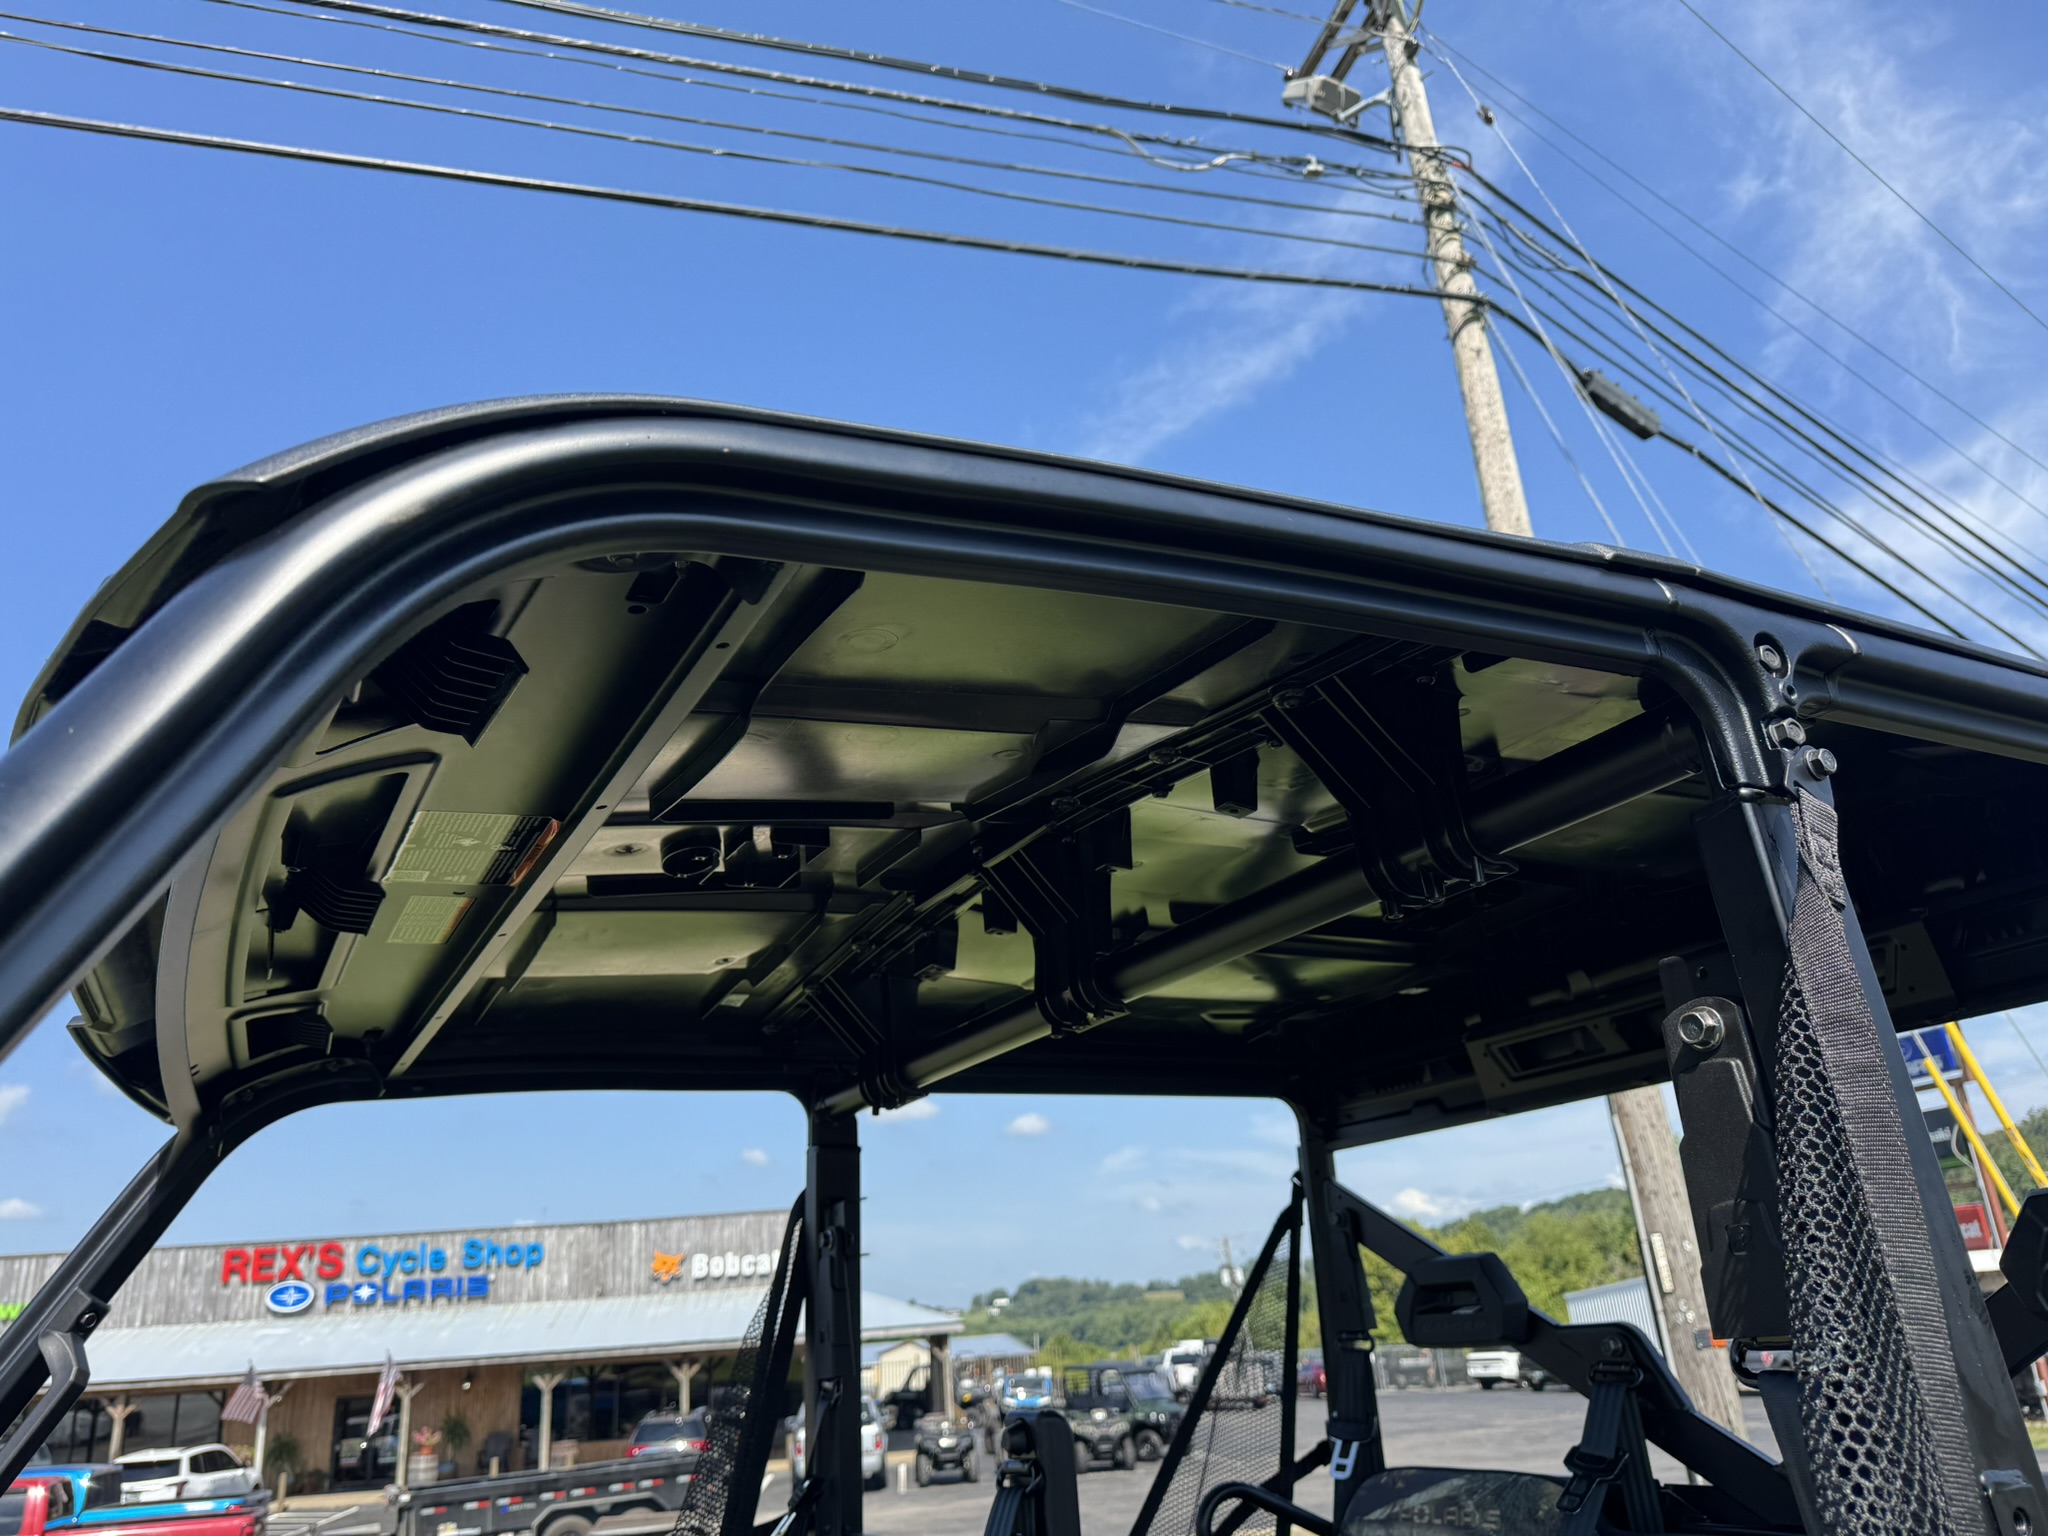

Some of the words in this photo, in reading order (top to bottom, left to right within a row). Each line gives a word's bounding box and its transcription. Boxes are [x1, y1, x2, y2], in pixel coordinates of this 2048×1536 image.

[221, 1241, 345, 1285] REX'S
[356, 1242, 447, 1280] Cycle
[463, 1237, 545, 1270] Shop
[324, 1274, 490, 1306] POLARIS
[1397, 1503, 1502, 1530] POLARIS
